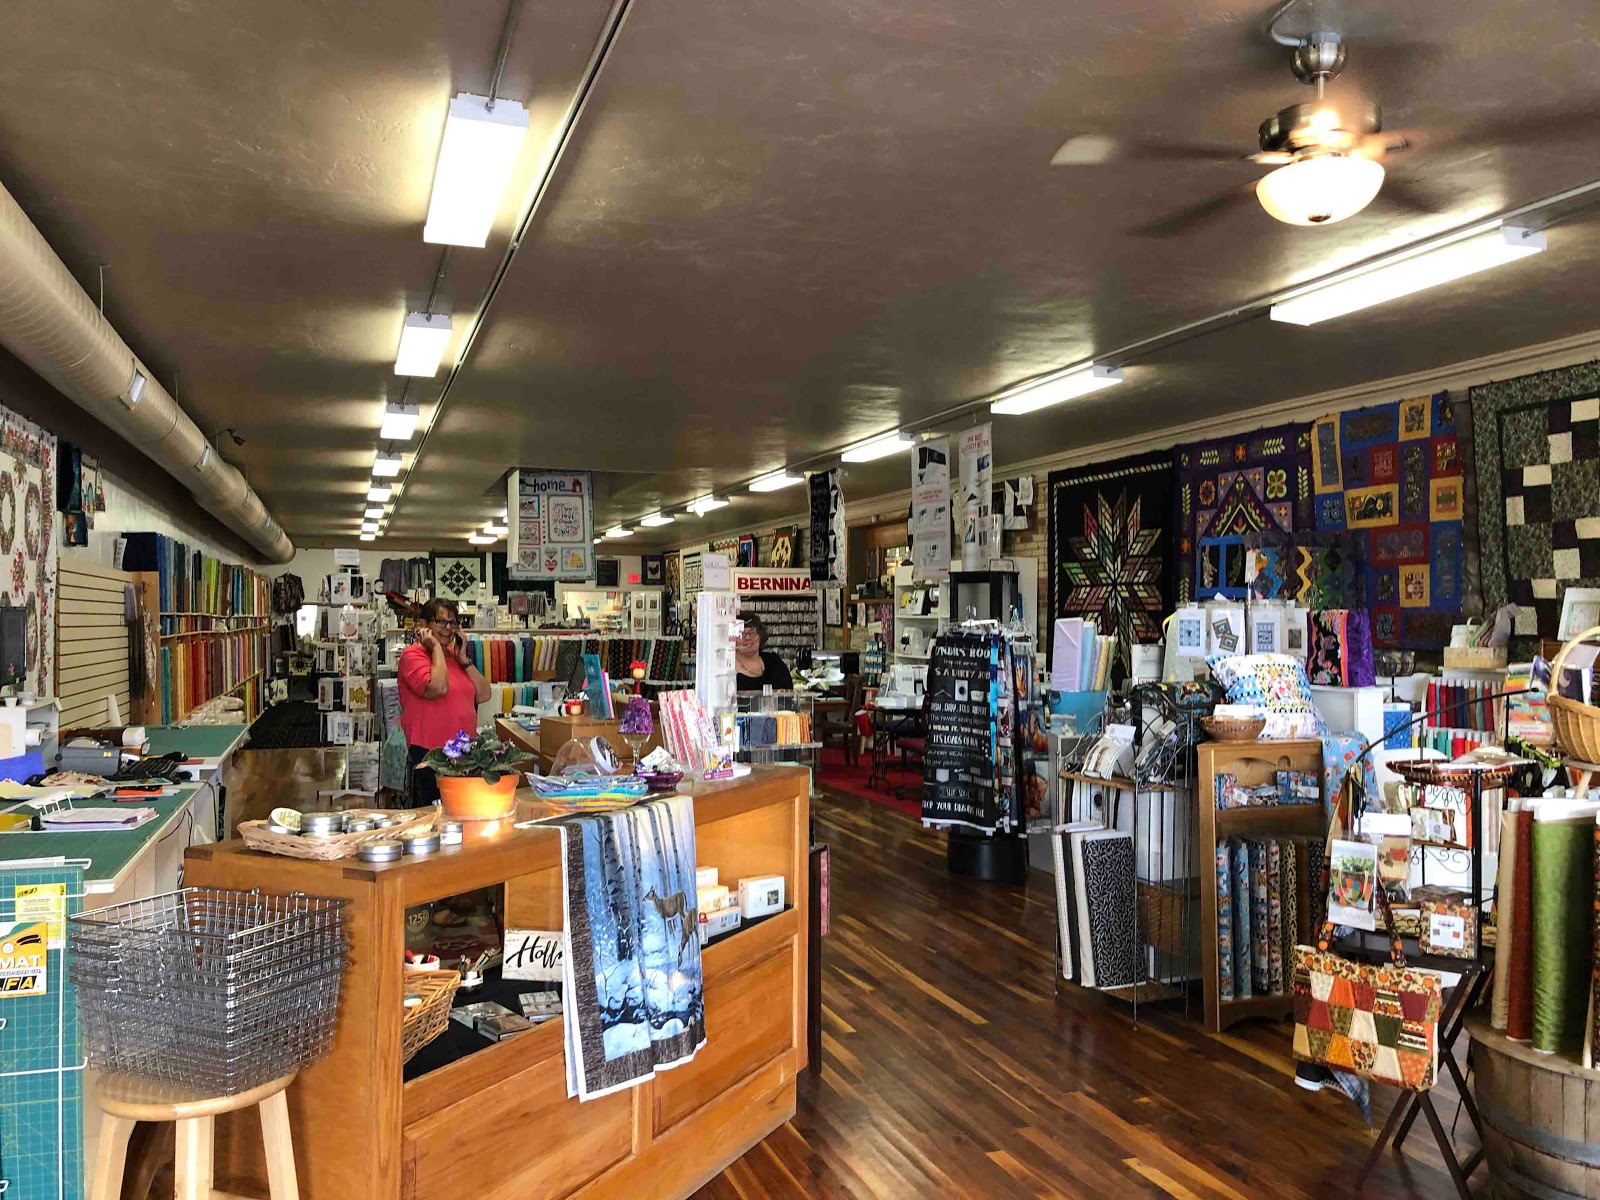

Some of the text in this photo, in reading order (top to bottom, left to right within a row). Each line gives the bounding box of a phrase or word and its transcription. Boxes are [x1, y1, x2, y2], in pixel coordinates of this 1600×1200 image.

[533, 479, 566, 493] home
[737, 577, 811, 591] BERNINA
[408, 912, 423, 925] 125
[0, 954, 42, 969] MAT
[0, 976, 36, 991] FA
